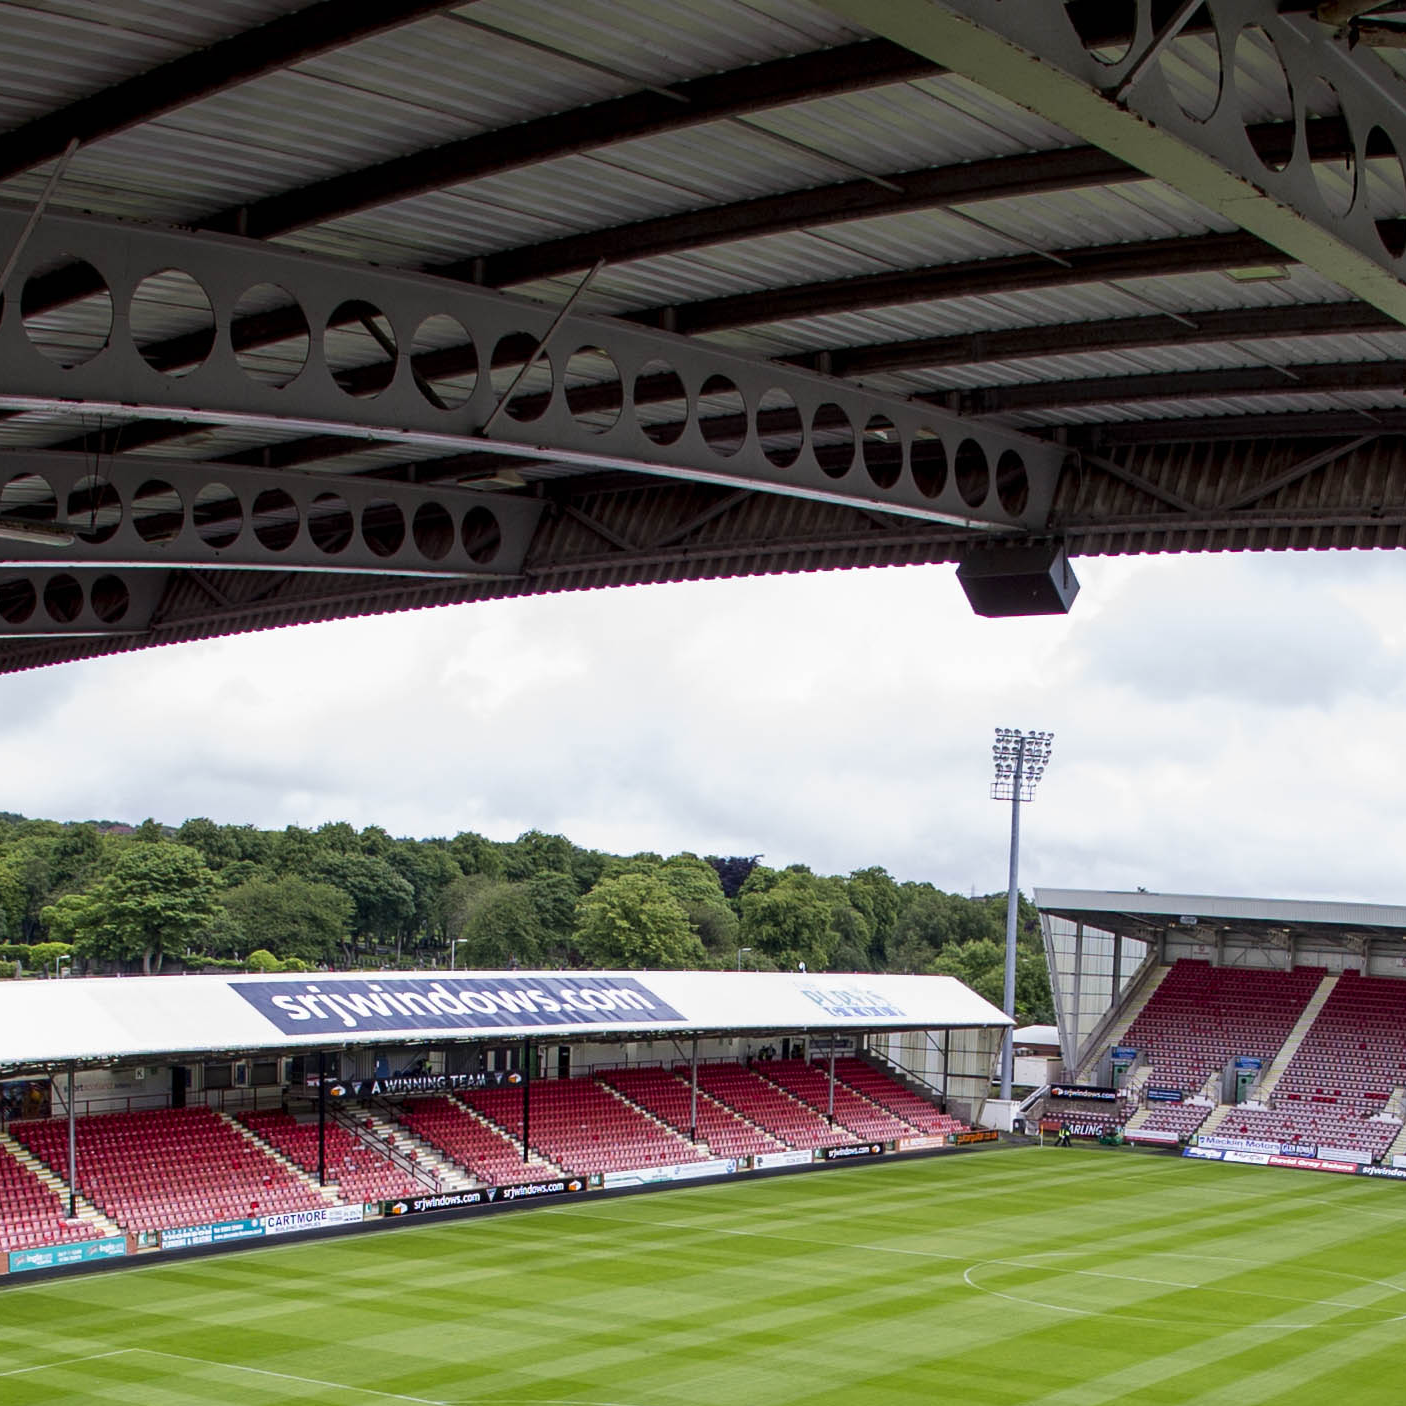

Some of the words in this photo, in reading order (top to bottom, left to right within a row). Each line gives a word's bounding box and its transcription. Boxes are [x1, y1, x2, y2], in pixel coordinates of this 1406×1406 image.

[271, 983, 656, 1028] srjwindows.com
[371, 1081, 381, 1095] A
[385, 1077, 445, 1092] WINNING
[450, 1074, 486, 1088] TEAM
[413, 1192, 481, 1212] srjwindows.com
[503, 1181, 565, 1200] srjwindows.com
[268, 1209, 327, 1228] CARTMORE
